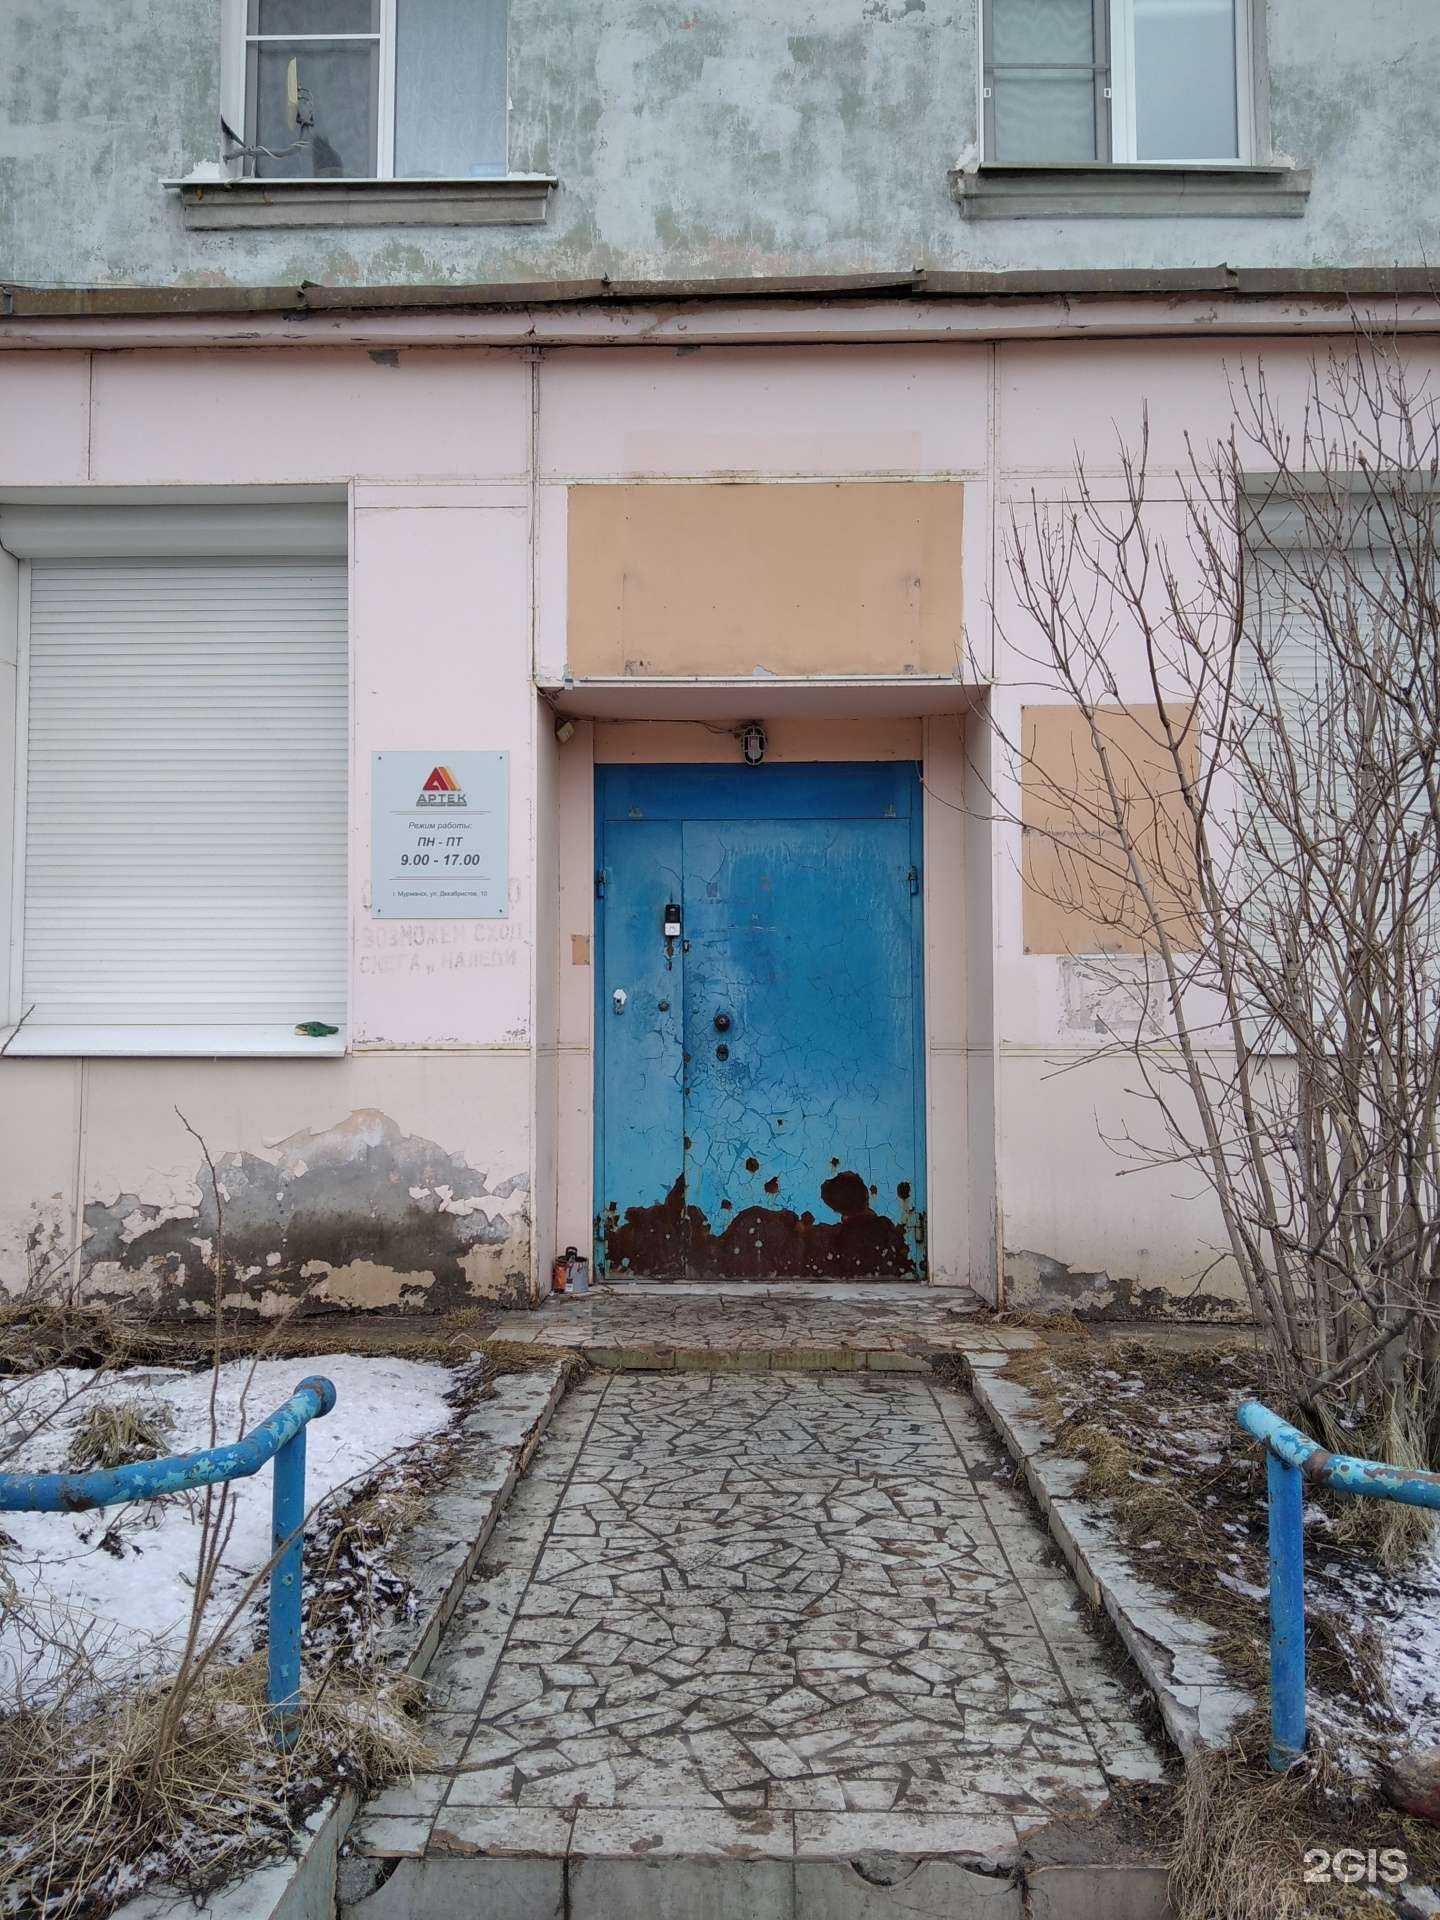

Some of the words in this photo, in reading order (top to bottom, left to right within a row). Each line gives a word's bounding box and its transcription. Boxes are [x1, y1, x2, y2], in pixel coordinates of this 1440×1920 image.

[416, 793, 467, 803] АРТЕК
[408, 821, 436, 830] Режим
[437, 821, 472, 832] работы:
[417, 836, 435, 847] ПН
[446, 836, 463, 847] ПТ
[400, 854, 430, 866] 9.00
[443, 854, 480, 866] 17.00
